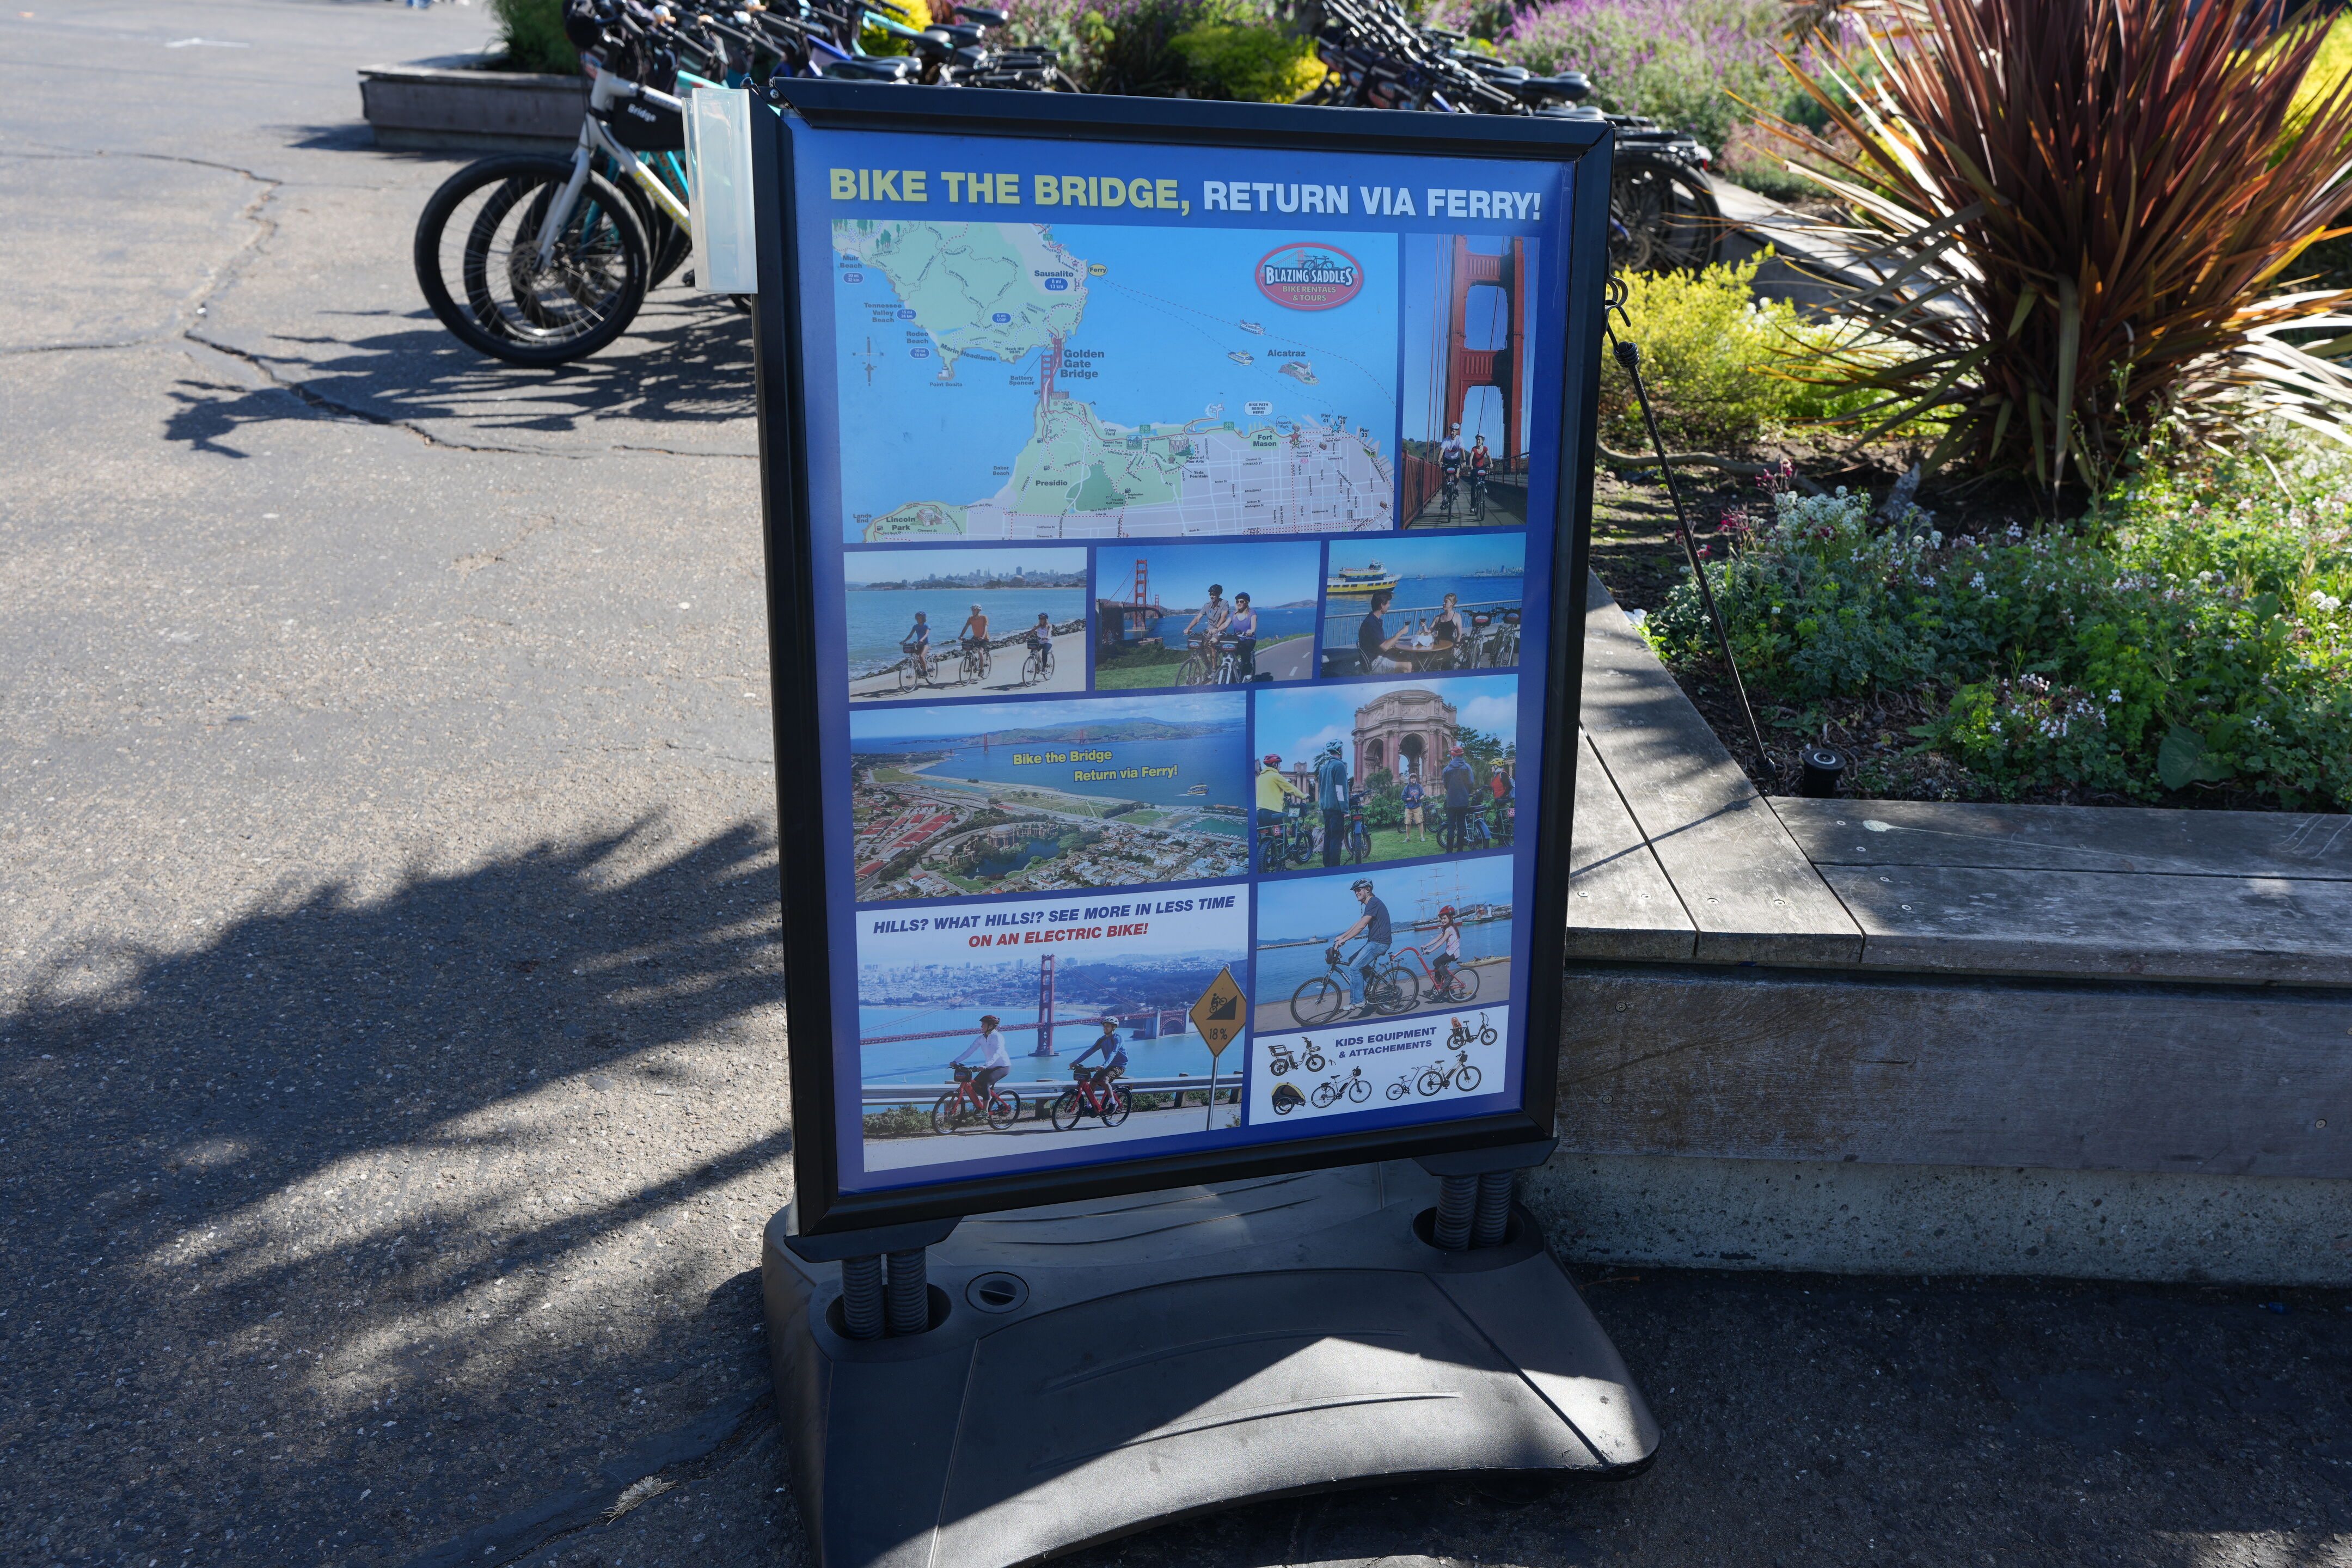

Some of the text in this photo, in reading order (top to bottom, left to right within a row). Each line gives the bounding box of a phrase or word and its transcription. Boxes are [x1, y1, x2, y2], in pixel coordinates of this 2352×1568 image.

[627, 103, 657, 122] Bridge
[830, 168, 1540, 220] BIKE THE BRIDGE, RETURN VIA FERRY!
[1266, 266, 1353, 285] BLAZING SADDLES
[940, 343, 996, 361] Marin Headlands
[1064, 350, 1105, 358] Golden
[1267, 349, 1306, 357] Alcatraz
[1061, 370, 1098, 379] Bridge
[1021, 476, 1030, 492] LINCOLN
[1337, 469, 1349, 483] COLUMBUS
[1013, 750, 1112, 765] Bike the Bridge
[1074, 765, 1178, 781] Return via Ferry!
[873, 896, 1235, 934] HILLS? WHAT HILLS!? SEE MORE IN LESS TIME
[969, 923, 1149, 947] ON AN ELECTRIC BIKE!
[1336, 1027, 1437, 1047] KIDS EQUIPMENT
[1349, 1040, 1432, 1057] ATTACHEMENTS
